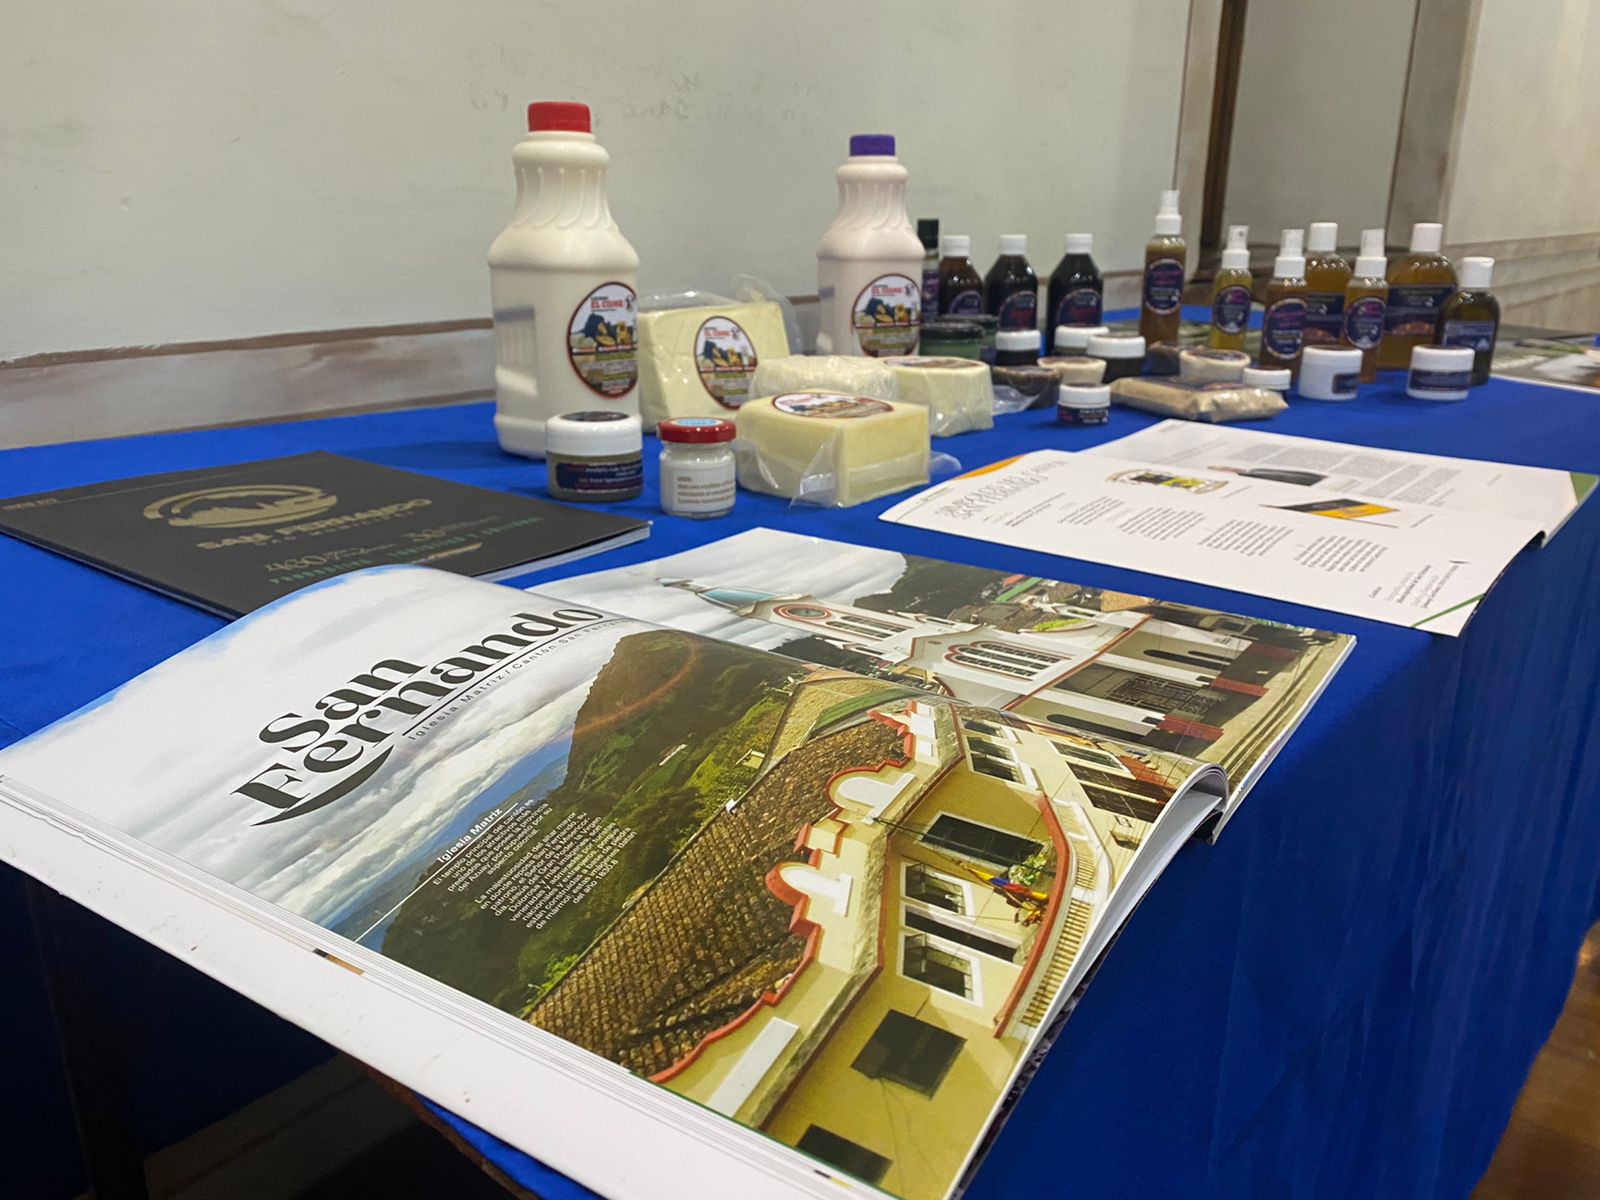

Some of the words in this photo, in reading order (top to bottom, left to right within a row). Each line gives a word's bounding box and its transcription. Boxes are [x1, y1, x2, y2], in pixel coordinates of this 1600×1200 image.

[230, 608, 604, 811] Fernando
[258, 658, 428, 753] San
[408, 706, 458, 740] Iglesia
[460, 673, 504, 704] Matriz
[512, 644, 557, 670] Cantón
[432, 877, 443, 885] El
[440, 857, 466, 878] templo
[464, 833, 494, 859] principal
[492, 824, 504, 834] del
[436, 834, 472, 863] Iglesia
[469, 808, 503, 835] Matriz
[451, 866, 466, 878] uno
[465, 857, 476, 866] de
[473, 848, 487, 858] los
[515, 809, 531, 822] más
[457, 880, 470, 892] del
[490, 850, 504, 862] por
[502, 824, 533, 851] supuesto
[531, 814, 544, 826] por
[542, 807, 553, 815] su
[474, 894, 487, 904] La
[484, 851, 536, 895] majestuosidad
[531, 841, 544, 852] del
[542, 829, 557, 843] altar
[555, 811, 576, 830] mayor
[479, 850, 494, 863] que
[492, 832, 514, 851] posee
[519, 802, 549, 828] provincia
[486, 850, 514, 875] aspecto
[507, 884, 541, 912] Dolorosa
[543, 865, 560, 880] más
[588, 824, 602, 836] son
[508, 884, 529, 904] Jesús
[527, 873, 540, 885] del
[537, 858, 556, 874] Gran
[579, 816, 602, 834] Virgen
[518, 876, 526, 884] el
[523, 858, 545, 877] Señor
[544, 850, 555, 859] de
[480, 900, 491, 909] en
[489, 880, 513, 901] donde
[510, 859, 535, 881] reposa
[532, 847, 548, 860] San
[509, 889, 546, 921] veneradas
[549, 853, 583, 885] admiradas
[581, 842, 593, 854] por
[521, 887, 558, 921] nacionales
[525, 909, 546, 928] están
[584, 853, 603, 869] base
[601, 845, 612, 854] de
[610, 826, 631, 846] piedra
[535, 919, 547, 929] de
[571, 876, 591, 894] estas
[587, 848, 620, 877] imágenes
[617, 831, 637, 848] datan
[572, 892, 585, 904] del
[583, 880, 598, 893] año
